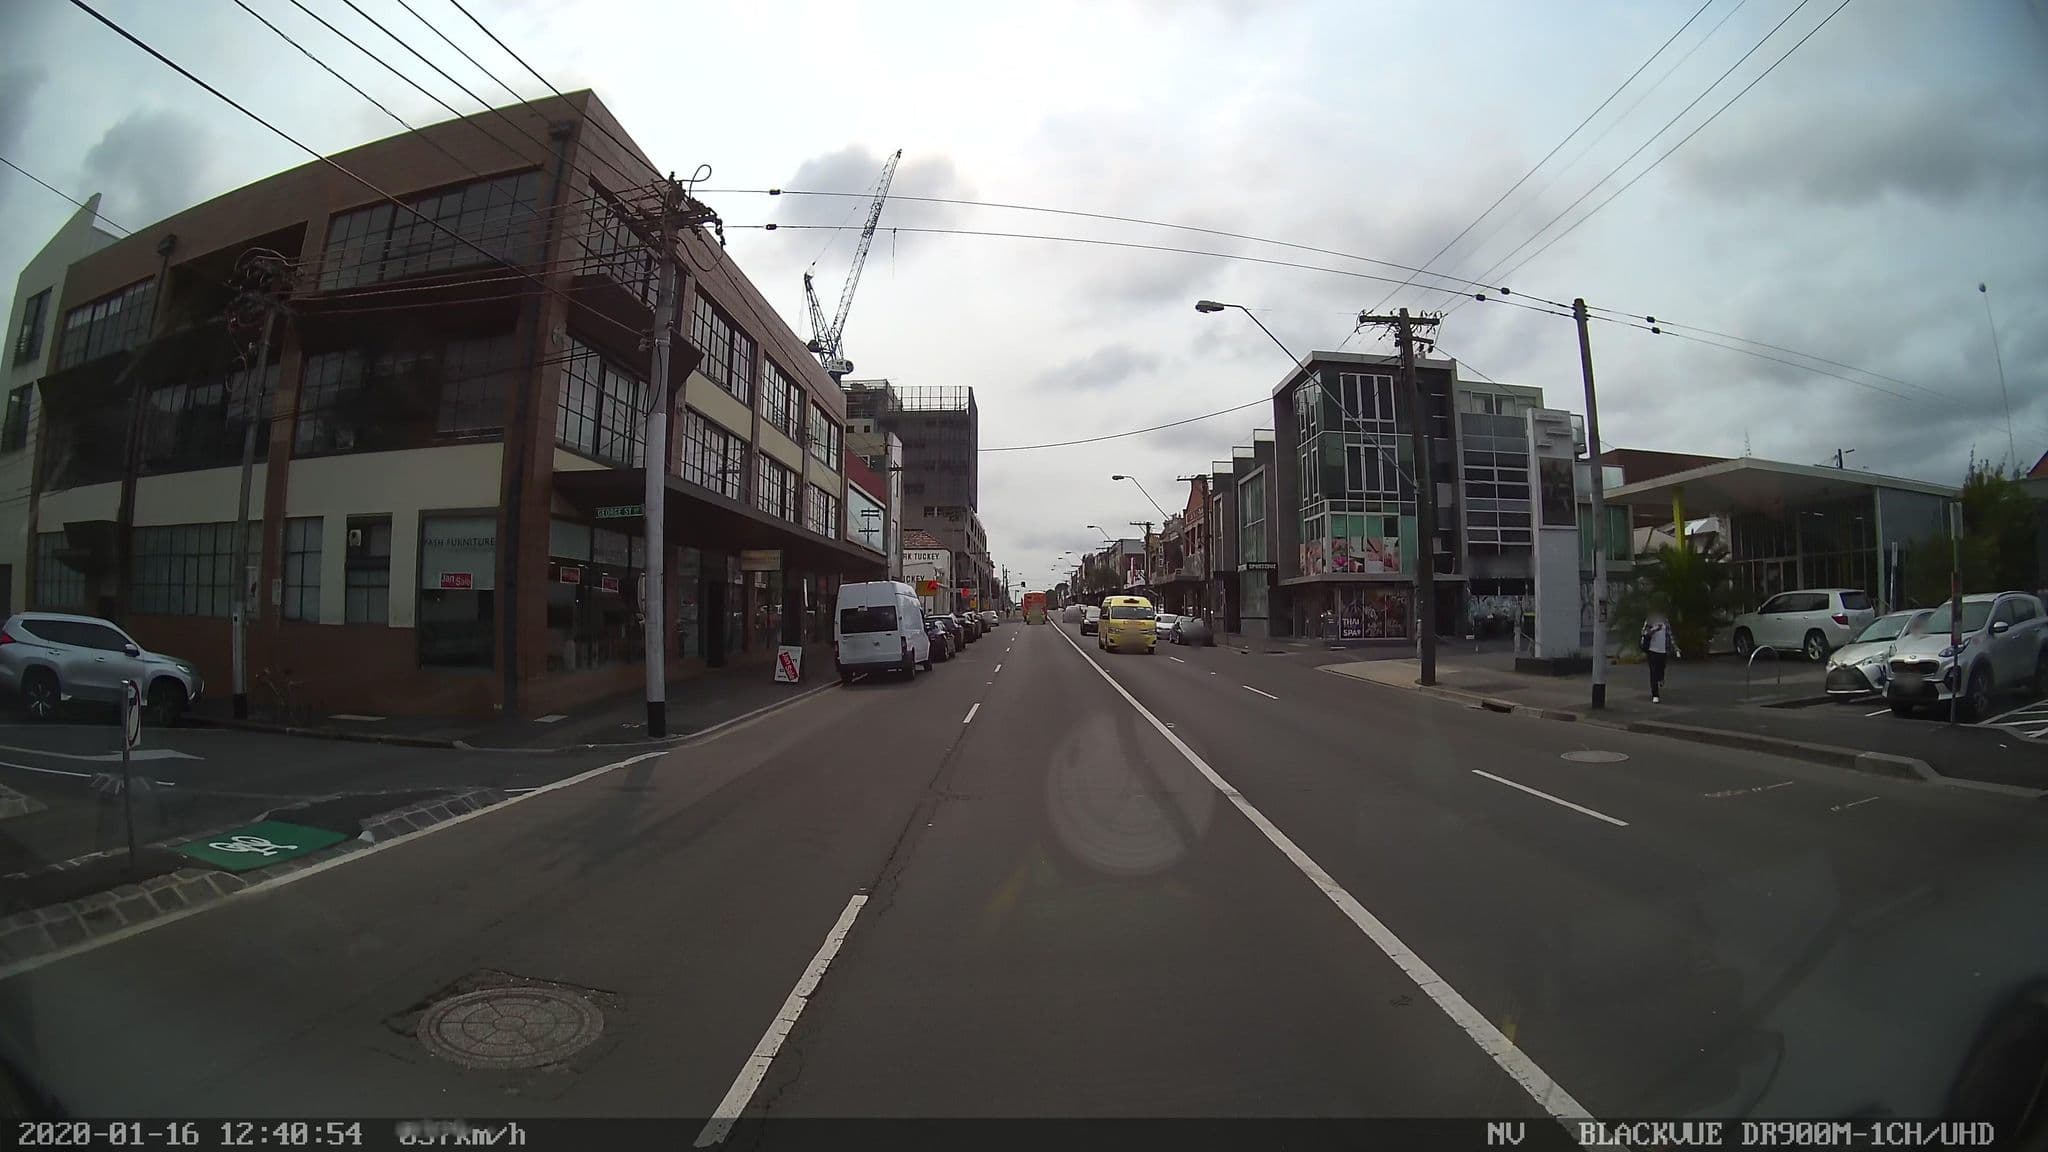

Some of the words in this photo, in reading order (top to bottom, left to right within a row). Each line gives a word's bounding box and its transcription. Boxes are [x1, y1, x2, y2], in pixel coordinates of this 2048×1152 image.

[597, 506, 623, 518] GEORGE
[446, 536, 496, 547] FURNITURE
[914, 552, 940, 561] TUCKEY
[442, 574, 455, 584] Jan
[1342, 618, 1360, 626] THAI
